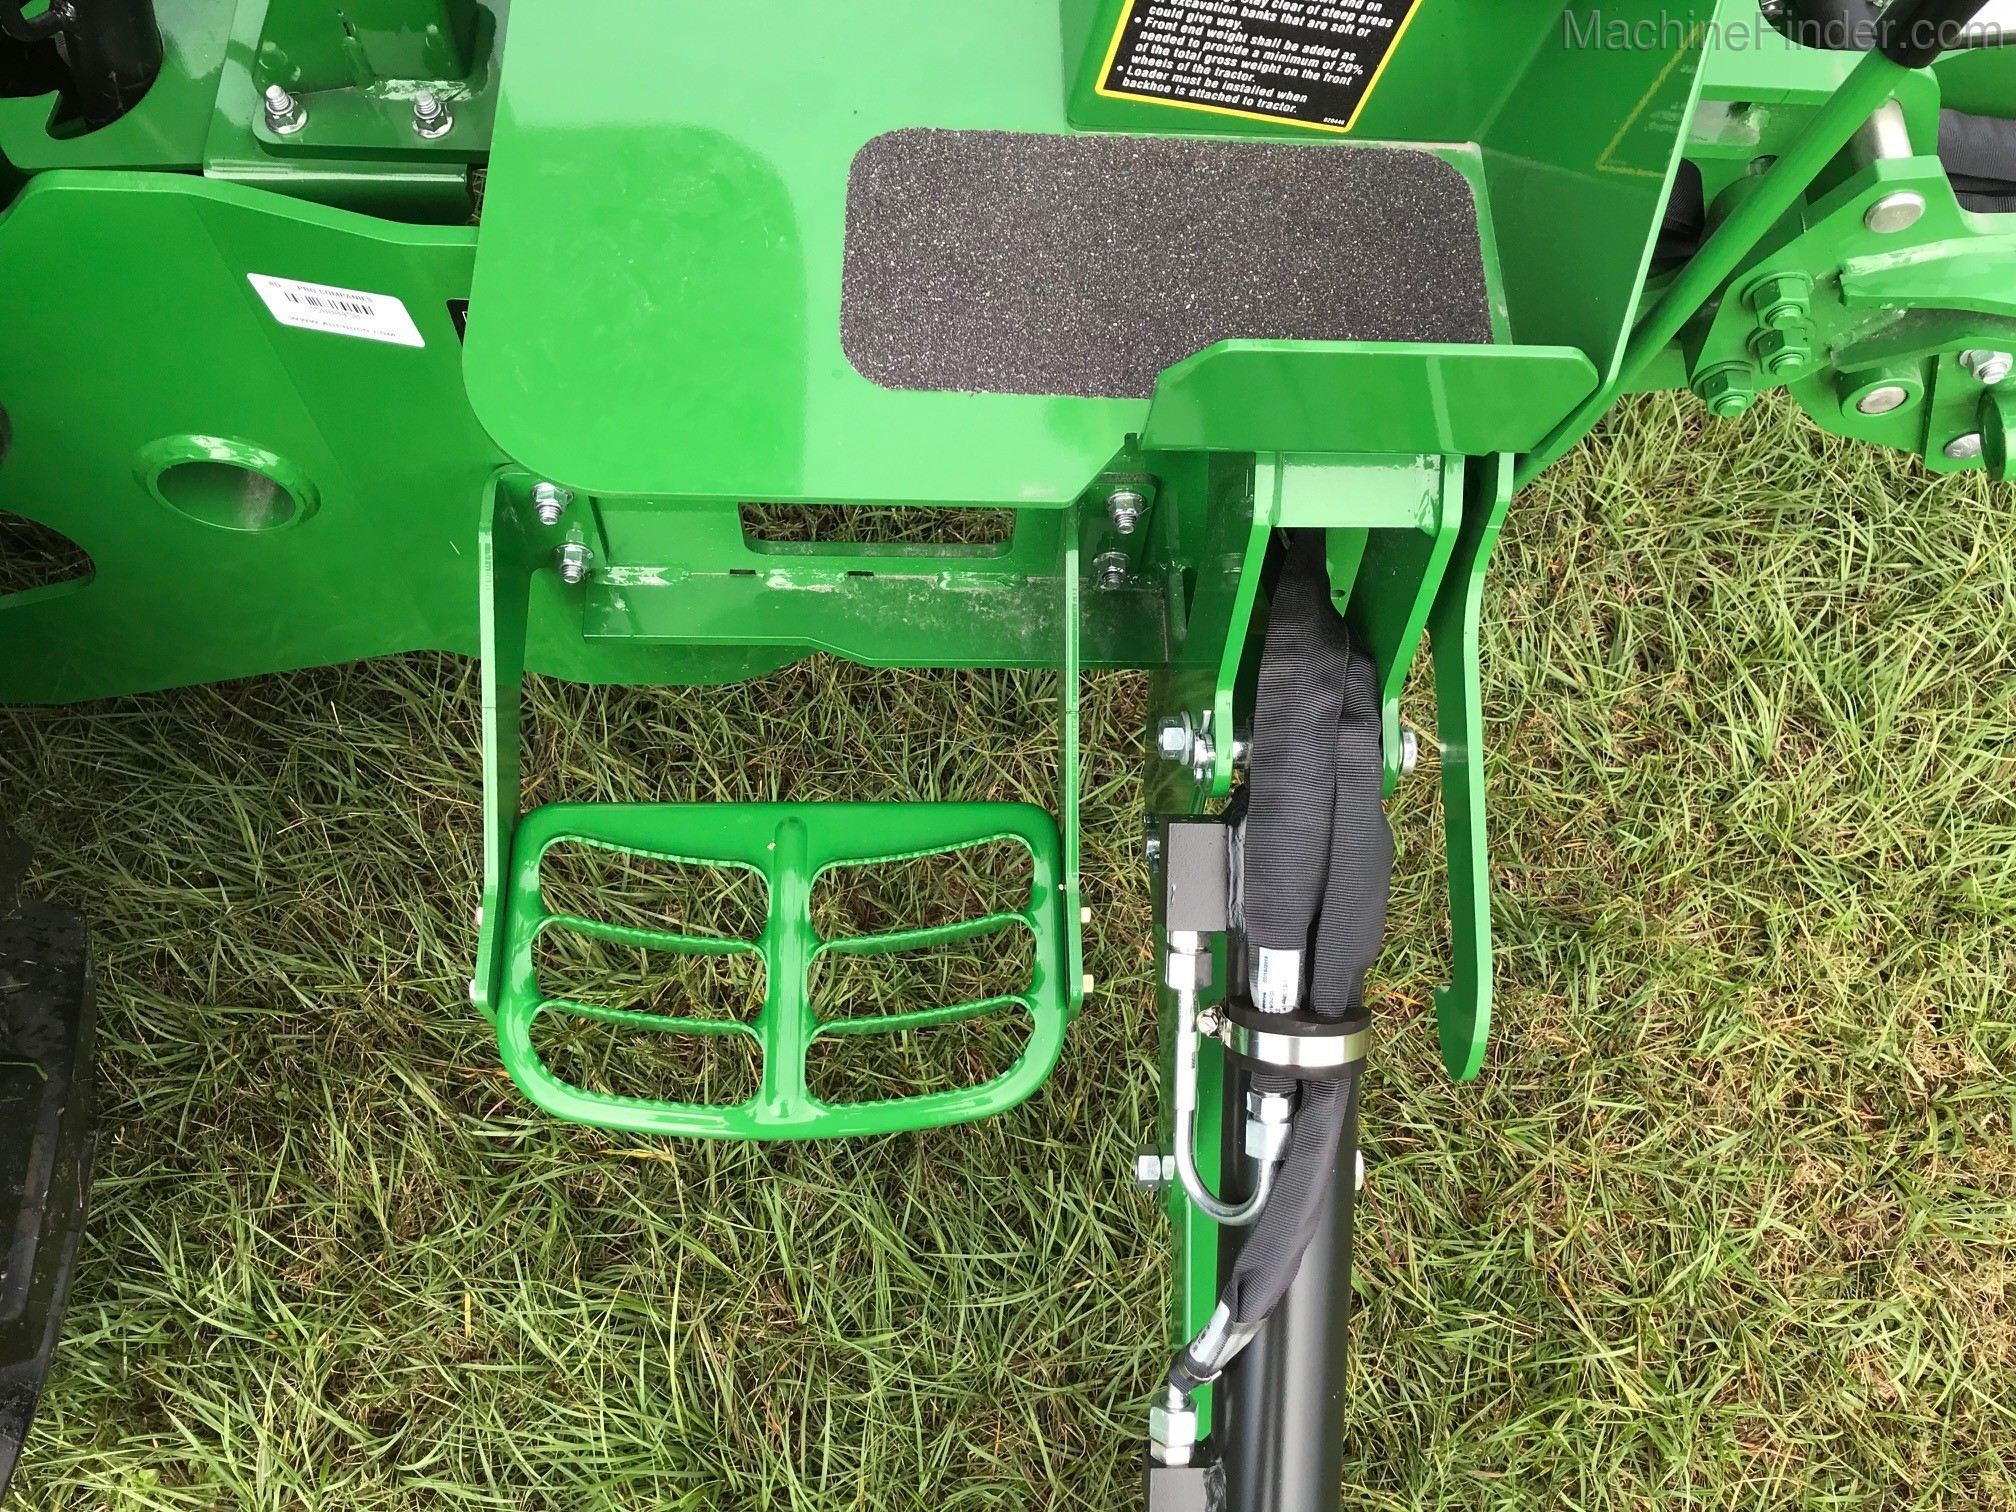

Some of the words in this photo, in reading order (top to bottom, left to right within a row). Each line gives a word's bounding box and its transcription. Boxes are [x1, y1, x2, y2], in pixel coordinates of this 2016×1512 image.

[1148, 6, 1185, 20] could
[1186, 11, 1213, 24] give
[1216, 17, 1243, 31] way.
[1170, 0, 1238, 15] excavation
[1240, 6, 1278, 22] banks
[1280, 13, 1306, 27] that
[1306, 19, 1329, 30] are
[1330, 23, 1356, 35] soft
[1356, 27, 1372, 38] or
[1271, 0, 1305, 13] clear
[1306, 5, 1322, 15] of
[1321, 7, 1356, 23] steep
[1358, 14, 1394, 28] areas
[1366, 2, 1383, 12] on
[1139, 30, 1186, 45] needed
[1188, 37, 1200, 48] to
[1202, 41, 1249, 56] provide
[1251, 50, 1260, 58] a
[1262, 50, 1320, 68] minimum
[1322, 60, 1337, 71] of
[1336, 61, 1364, 75] 20%
[1144, 17, 1178, 32] Front
[1180, 24, 1204, 36] end
[1206, 28, 1249, 44] weight
[1250, 35, 1282, 48] shall
[1283, 39, 1299, 52] be
[1302, 44, 1341, 60] added
[1341, 51, 1357, 61] as
[1131, 54, 1174, 70] wheels
[1177, 61, 1191, 72] of
[1191, 62, 1212, 75] the
[1214, 66, 1256, 83] tractor.
[1135, 43, 1150, 53] of
[1150, 44, 1171, 56] the
[1173, 47, 1202, 61] total
[1204, 53, 1238, 67] gross
[1240, 59, 1284, 74] weight
[1283, 66, 1299, 77] on
[1301, 68, 1321, 81] the
[1323, 73, 1353, 86] front
[1122, 77, 1172, 93] backhoe
[1174, 85, 1186, 96] is
[1188, 88, 1241, 104] attached
[1242, 95, 1255, 107] to
[1257, 97, 1298, 114] tractor.
[1126, 65, 1170, 81] Loader
[1171, 73, 1202, 86] must
[1203, 77, 1219, 89] be
[1222, 80, 1275, 98] installed
[1276, 90, 1308, 103] when
[297, 285, 317, 294] PRO
[319, 288, 373, 303] COMPANIES
